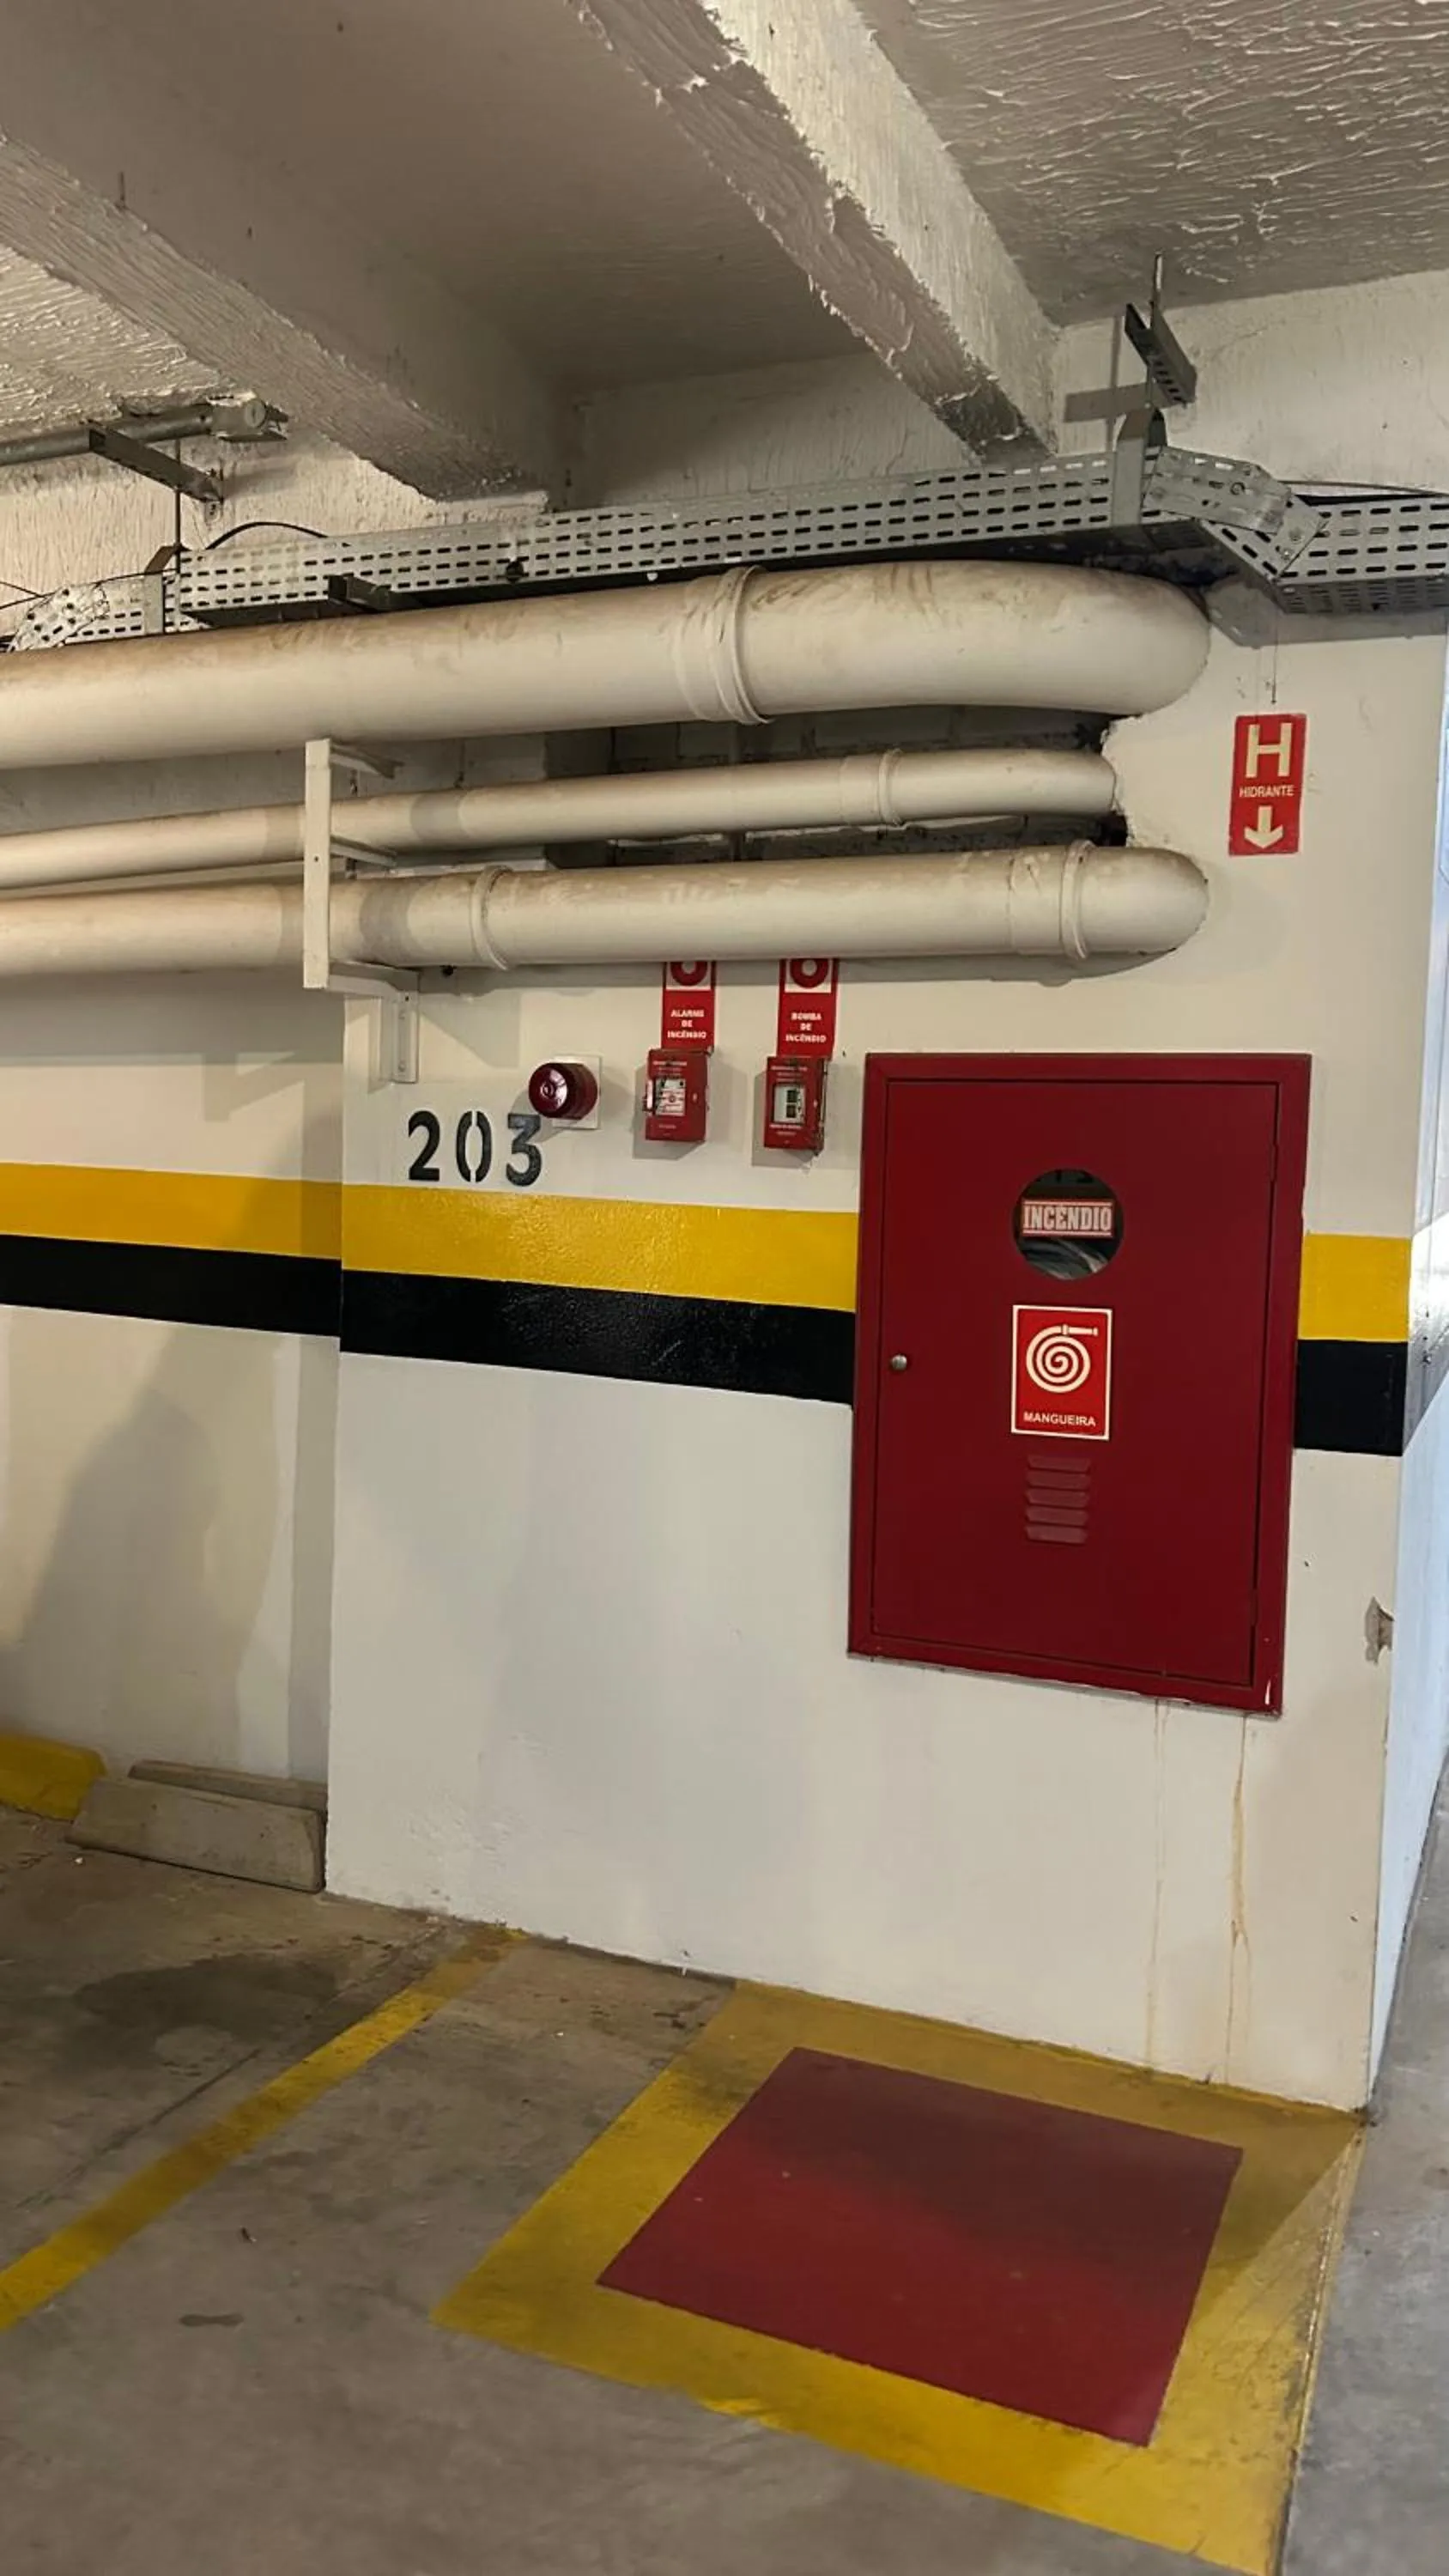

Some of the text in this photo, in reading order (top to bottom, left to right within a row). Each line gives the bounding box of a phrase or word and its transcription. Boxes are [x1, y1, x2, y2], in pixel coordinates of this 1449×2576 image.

[1246, 722, 1293, 778] H
[1239, 784, 1295, 798] HIDRANTE
[670, 1009, 705, 1018] ALARME
[667, 1029, 706, 1039] INCÊNDIO
[785, 1032, 827, 1043] INCÊNDIO
[408, 1110, 543, 1186] 203
[1023, 1411, 1096, 1427] MANGUEIRA
